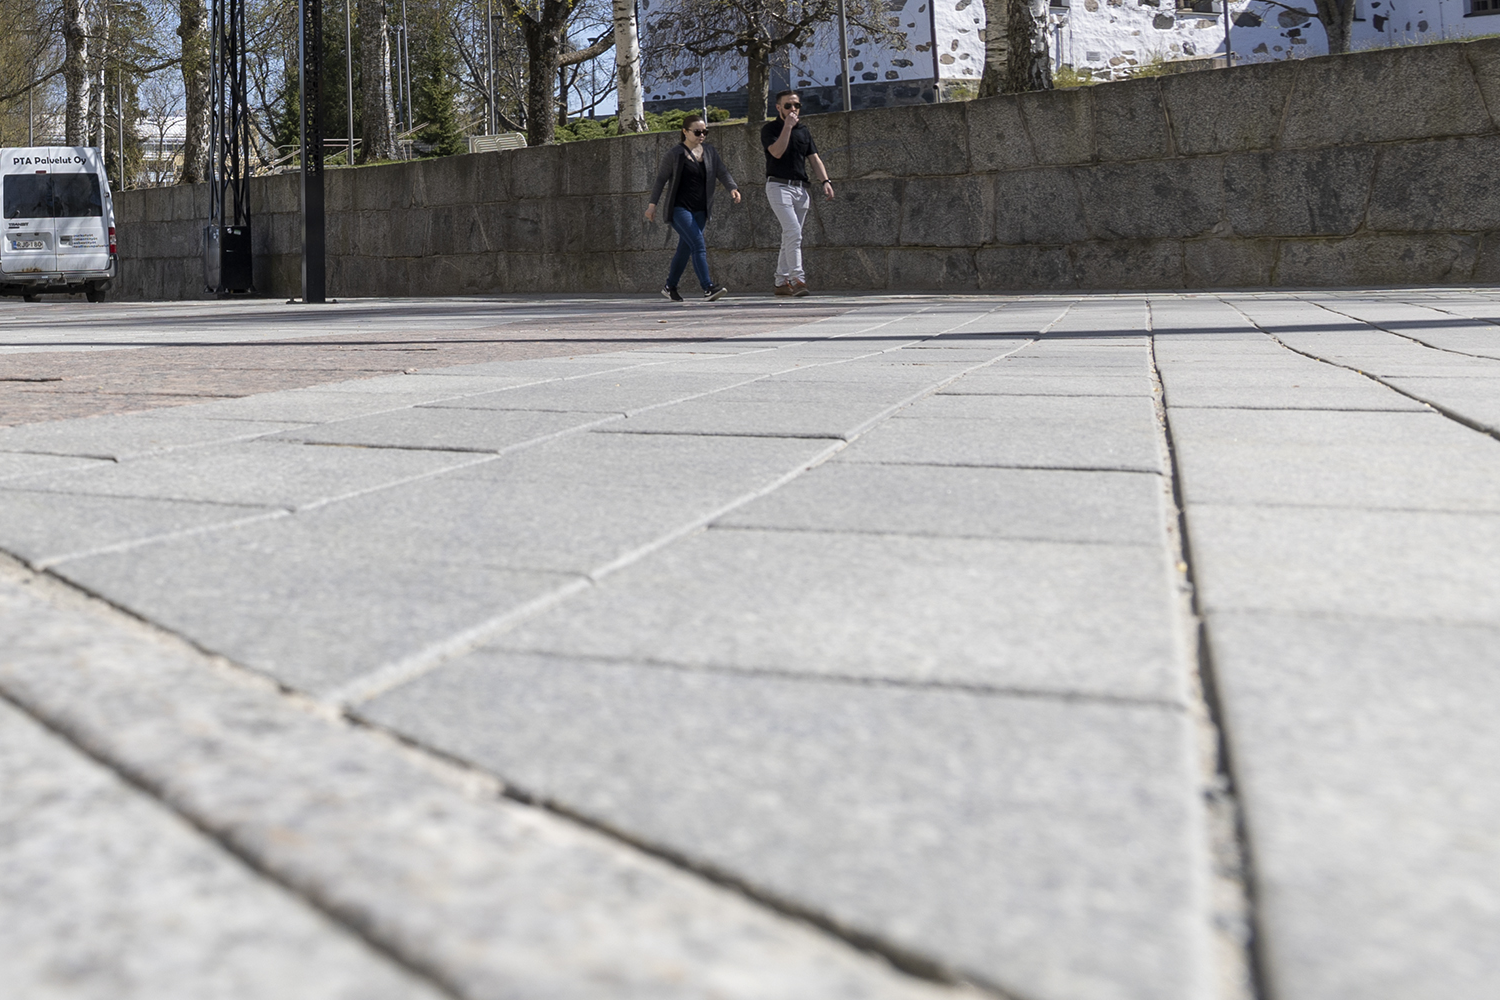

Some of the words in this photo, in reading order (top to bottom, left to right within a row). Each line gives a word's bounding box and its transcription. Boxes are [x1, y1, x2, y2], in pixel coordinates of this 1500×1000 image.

[13, 157, 32, 165] PTA
[34, 156, 72, 165] Palvelut
[73, 156, 87, 165] Oy
